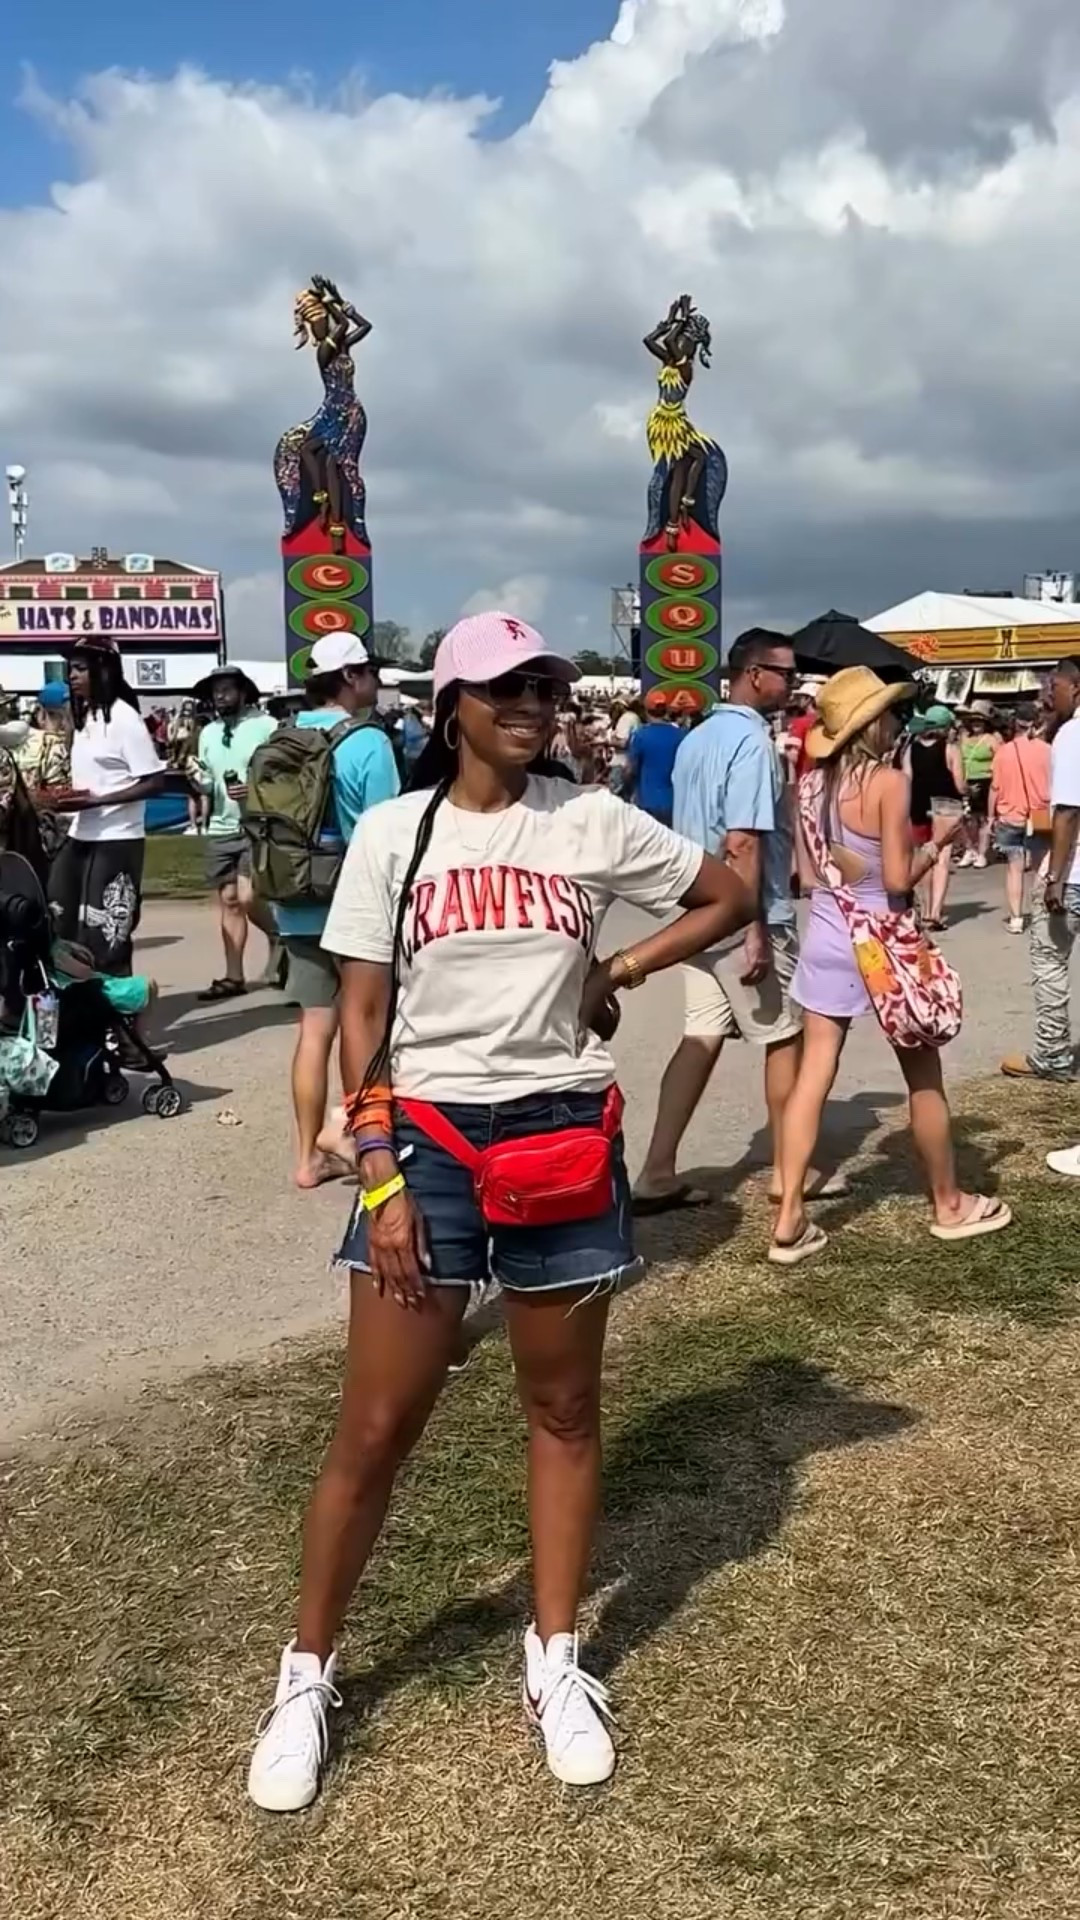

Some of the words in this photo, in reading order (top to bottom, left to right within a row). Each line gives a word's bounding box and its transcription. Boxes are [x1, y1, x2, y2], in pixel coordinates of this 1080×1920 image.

[17, 606, 76, 630] HATS
[82, 608, 94, 630] &
[99, 606, 213, 630] BANDANAS
[312, 564, 346, 630] CO
